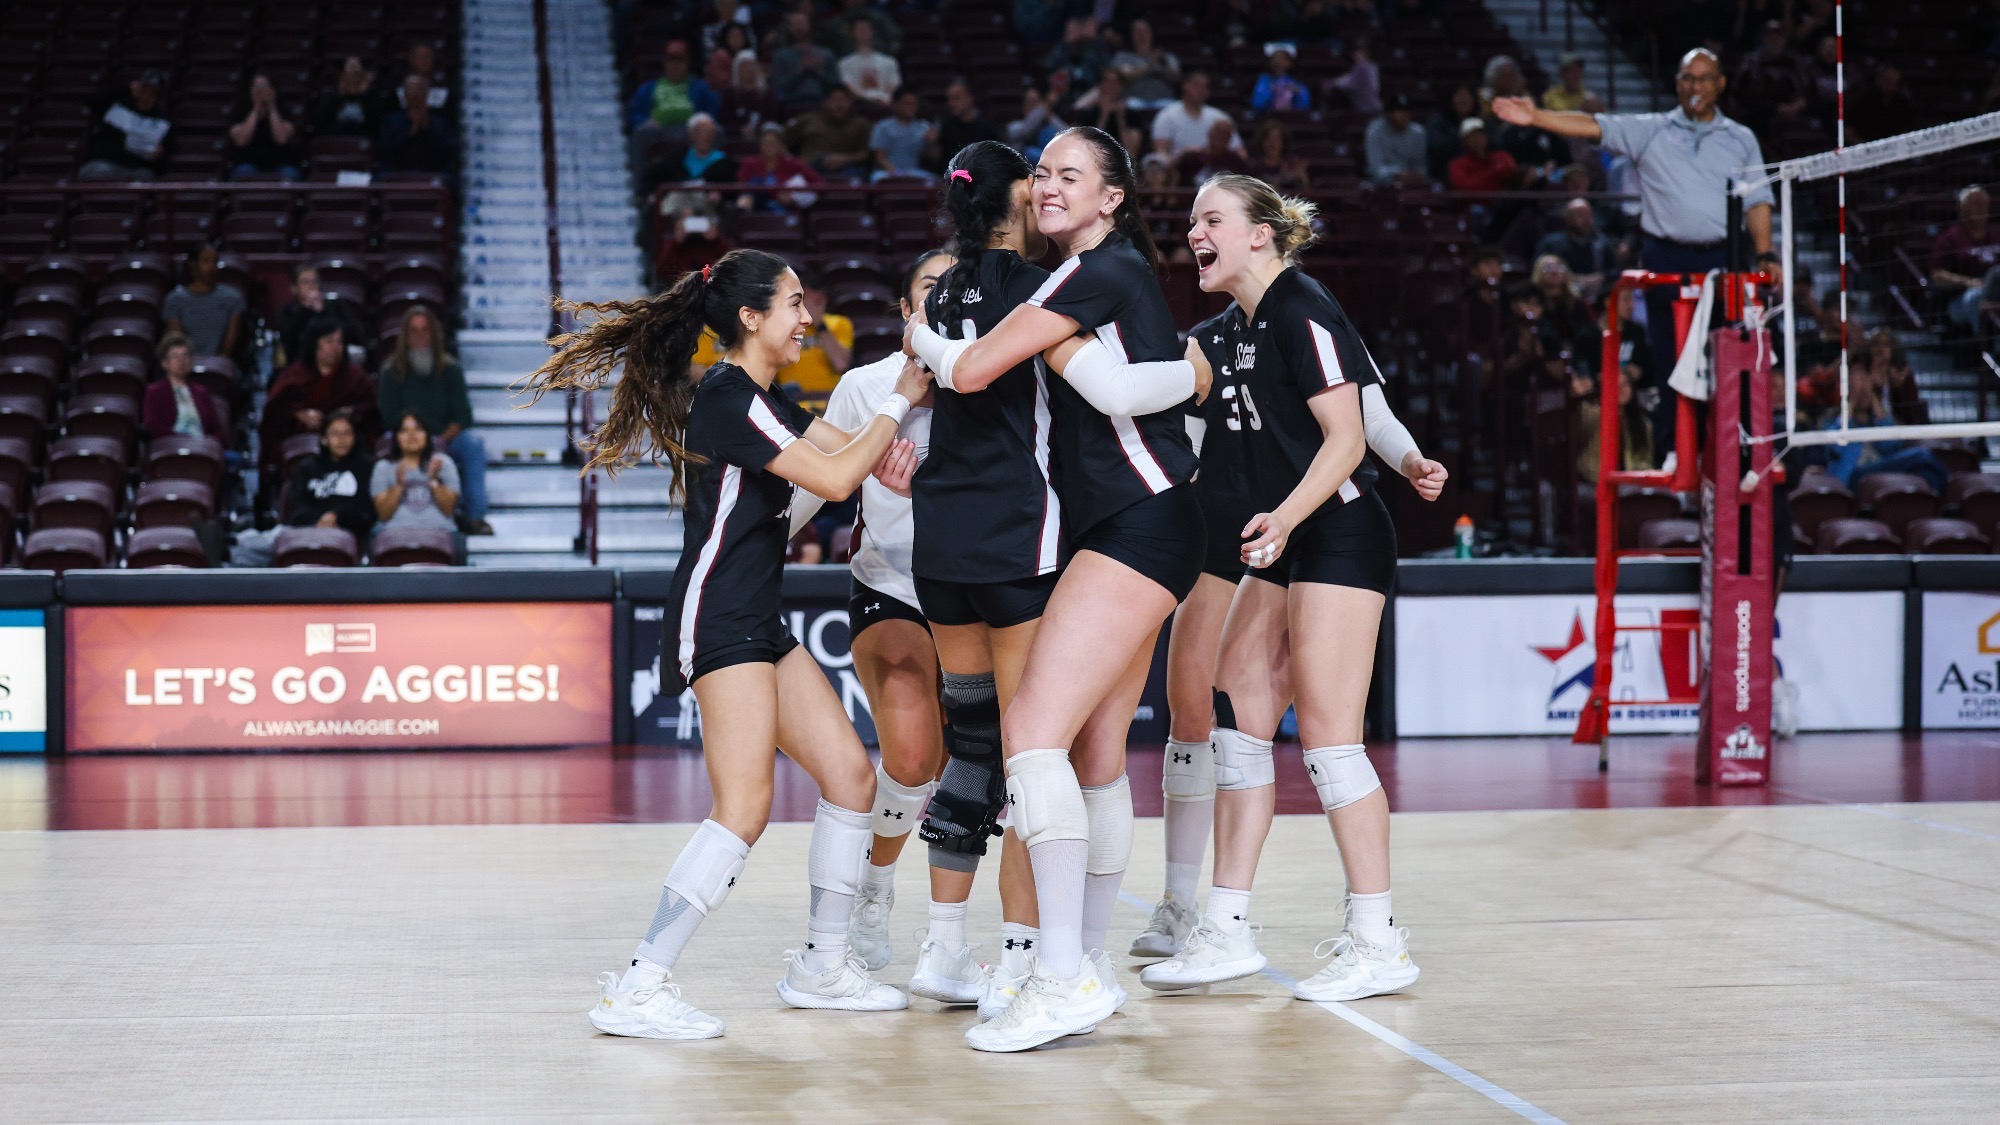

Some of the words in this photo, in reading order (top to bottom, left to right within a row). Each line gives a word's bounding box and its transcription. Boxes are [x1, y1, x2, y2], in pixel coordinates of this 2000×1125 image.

[1735, 600, 1752, 650] sports
[124, 667, 257, 705] LET'S
[271, 666, 347, 704] GO
[361, 664, 559, 703] AGGIES!
[1734, 651, 1752, 712] imports
[243, 718, 440, 737] ALWAYSANAGGIE.COM
